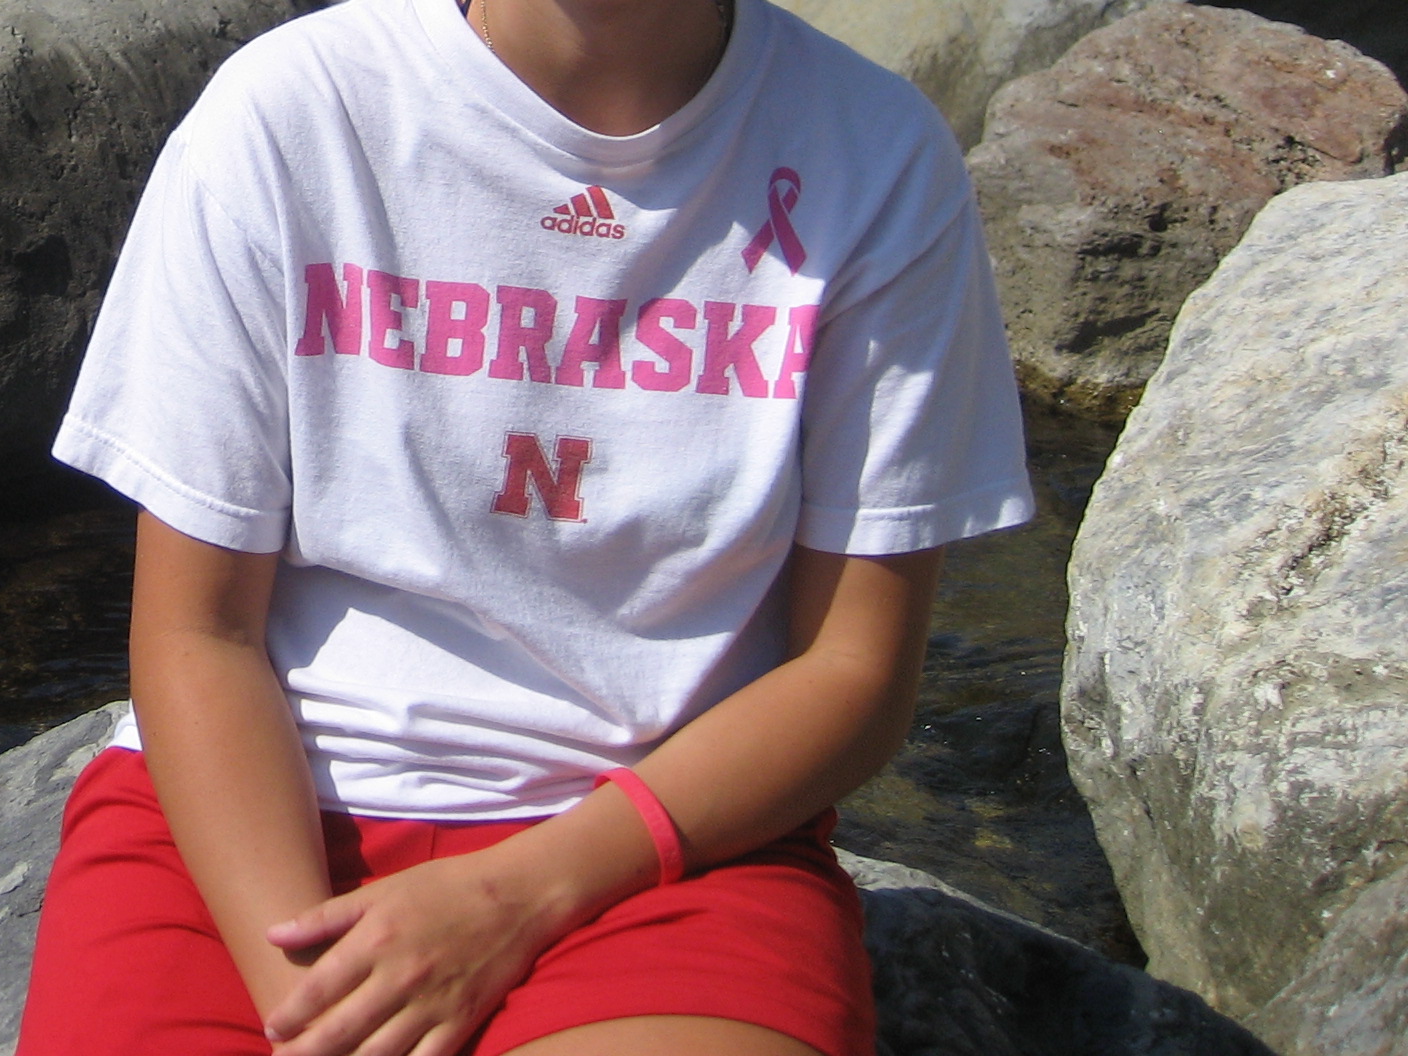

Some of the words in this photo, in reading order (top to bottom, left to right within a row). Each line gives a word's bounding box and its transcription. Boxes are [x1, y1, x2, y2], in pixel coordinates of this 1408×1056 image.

[540, 214, 626, 240] adidas
[295, 262, 821, 400] NEBRASKA
[490, 430, 593, 523] N
